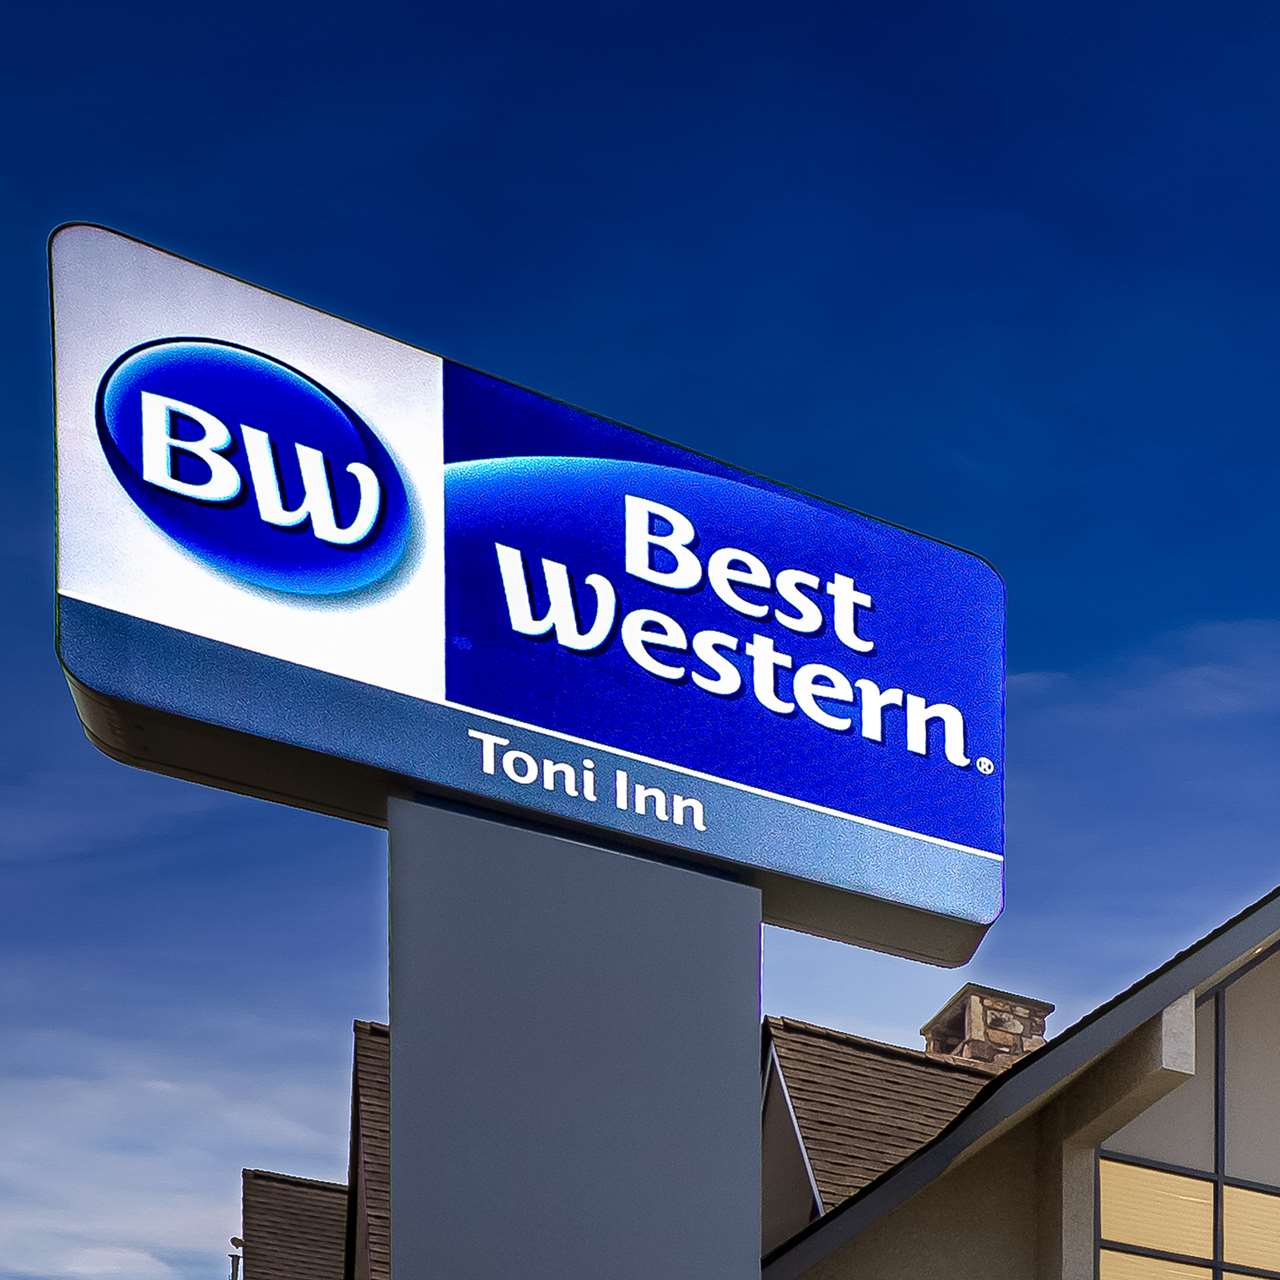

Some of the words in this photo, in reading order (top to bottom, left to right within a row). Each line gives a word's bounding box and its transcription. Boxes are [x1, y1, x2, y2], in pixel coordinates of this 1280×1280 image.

[140, 390, 380, 544] BW
[624, 493, 873, 653] Best
[467, 727, 596, 803] Toni
[614, 768, 708, 833] Inn
